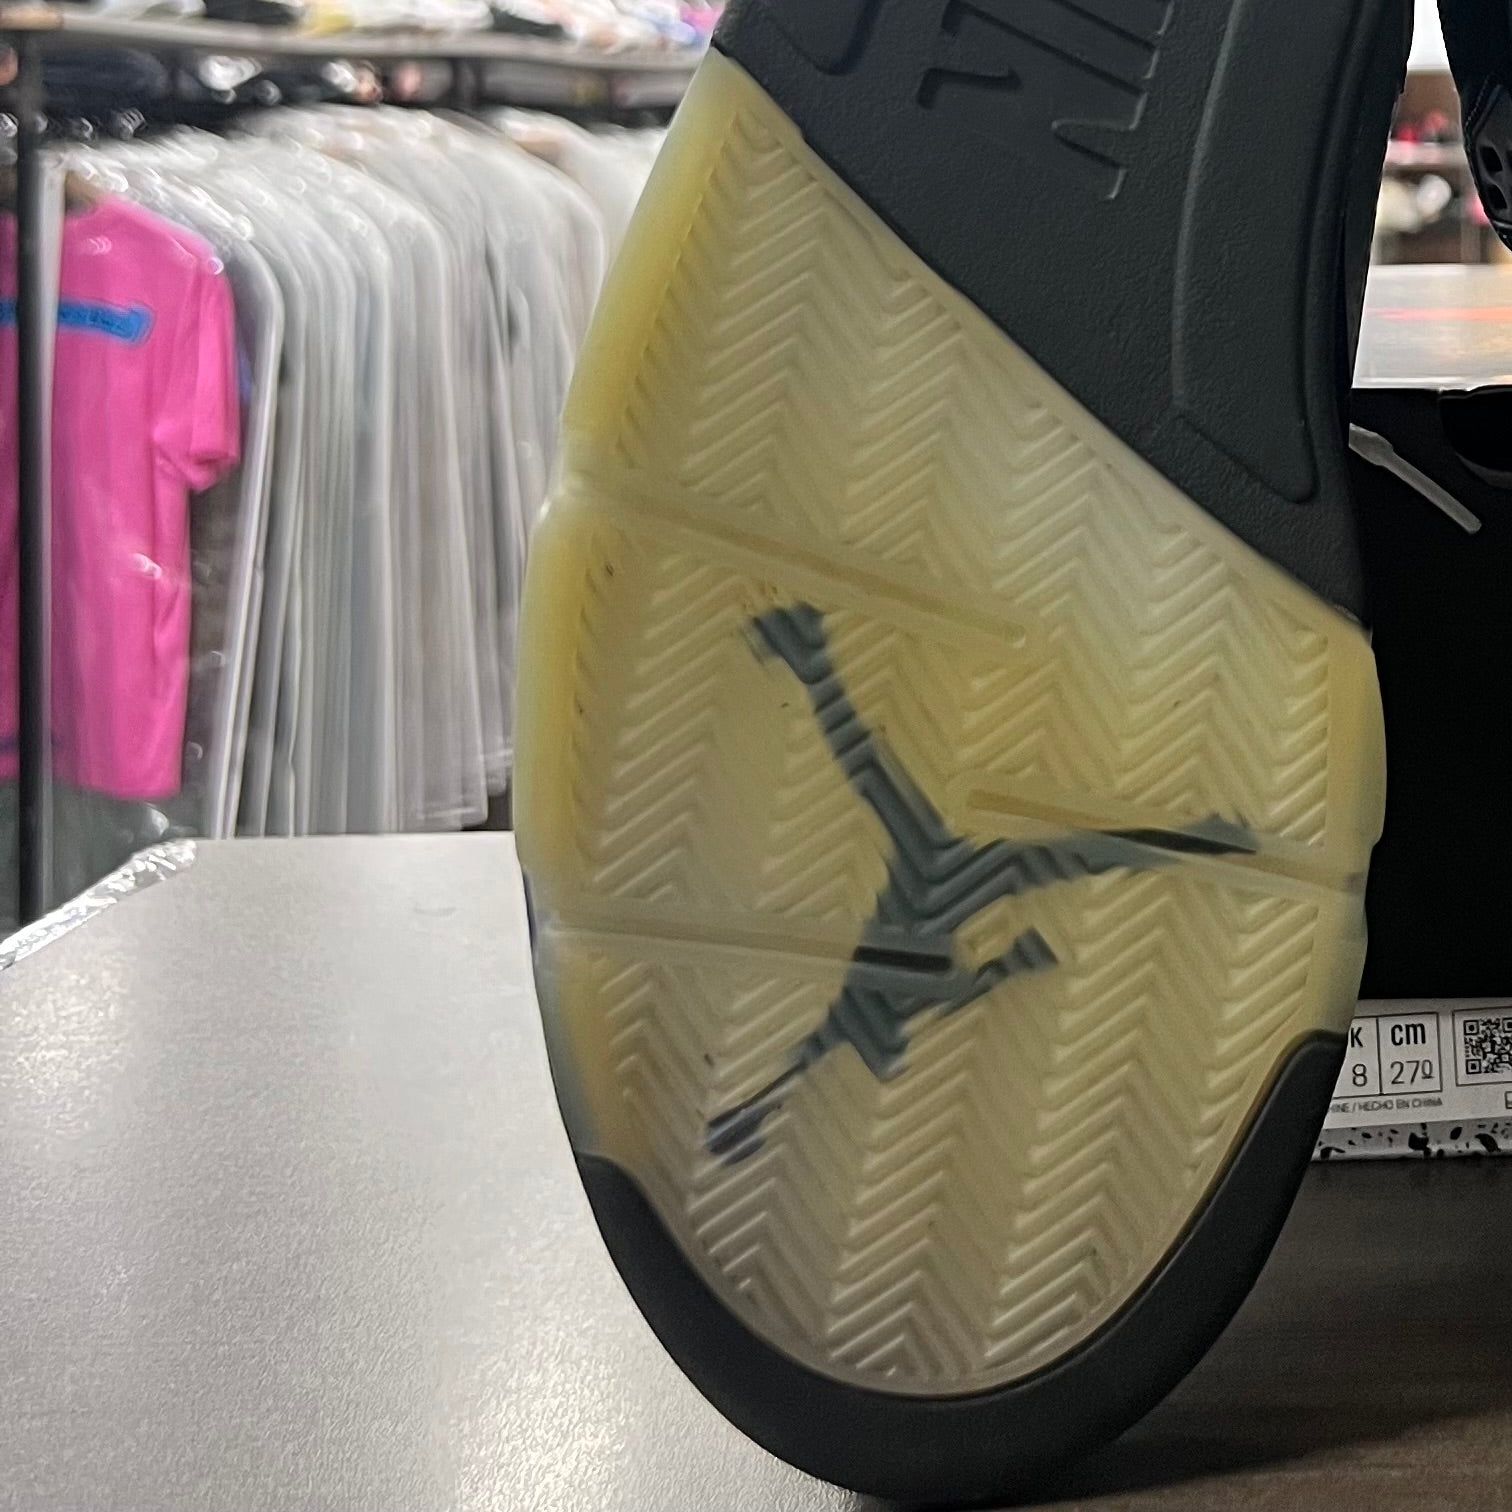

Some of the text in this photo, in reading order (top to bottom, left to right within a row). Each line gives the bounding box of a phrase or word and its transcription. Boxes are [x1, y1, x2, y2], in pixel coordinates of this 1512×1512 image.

[1348, 1026, 1364, 1049] K
[1390, 1021, 1427, 1047] cm
[1351, 1063, 1368, 1088] 8
